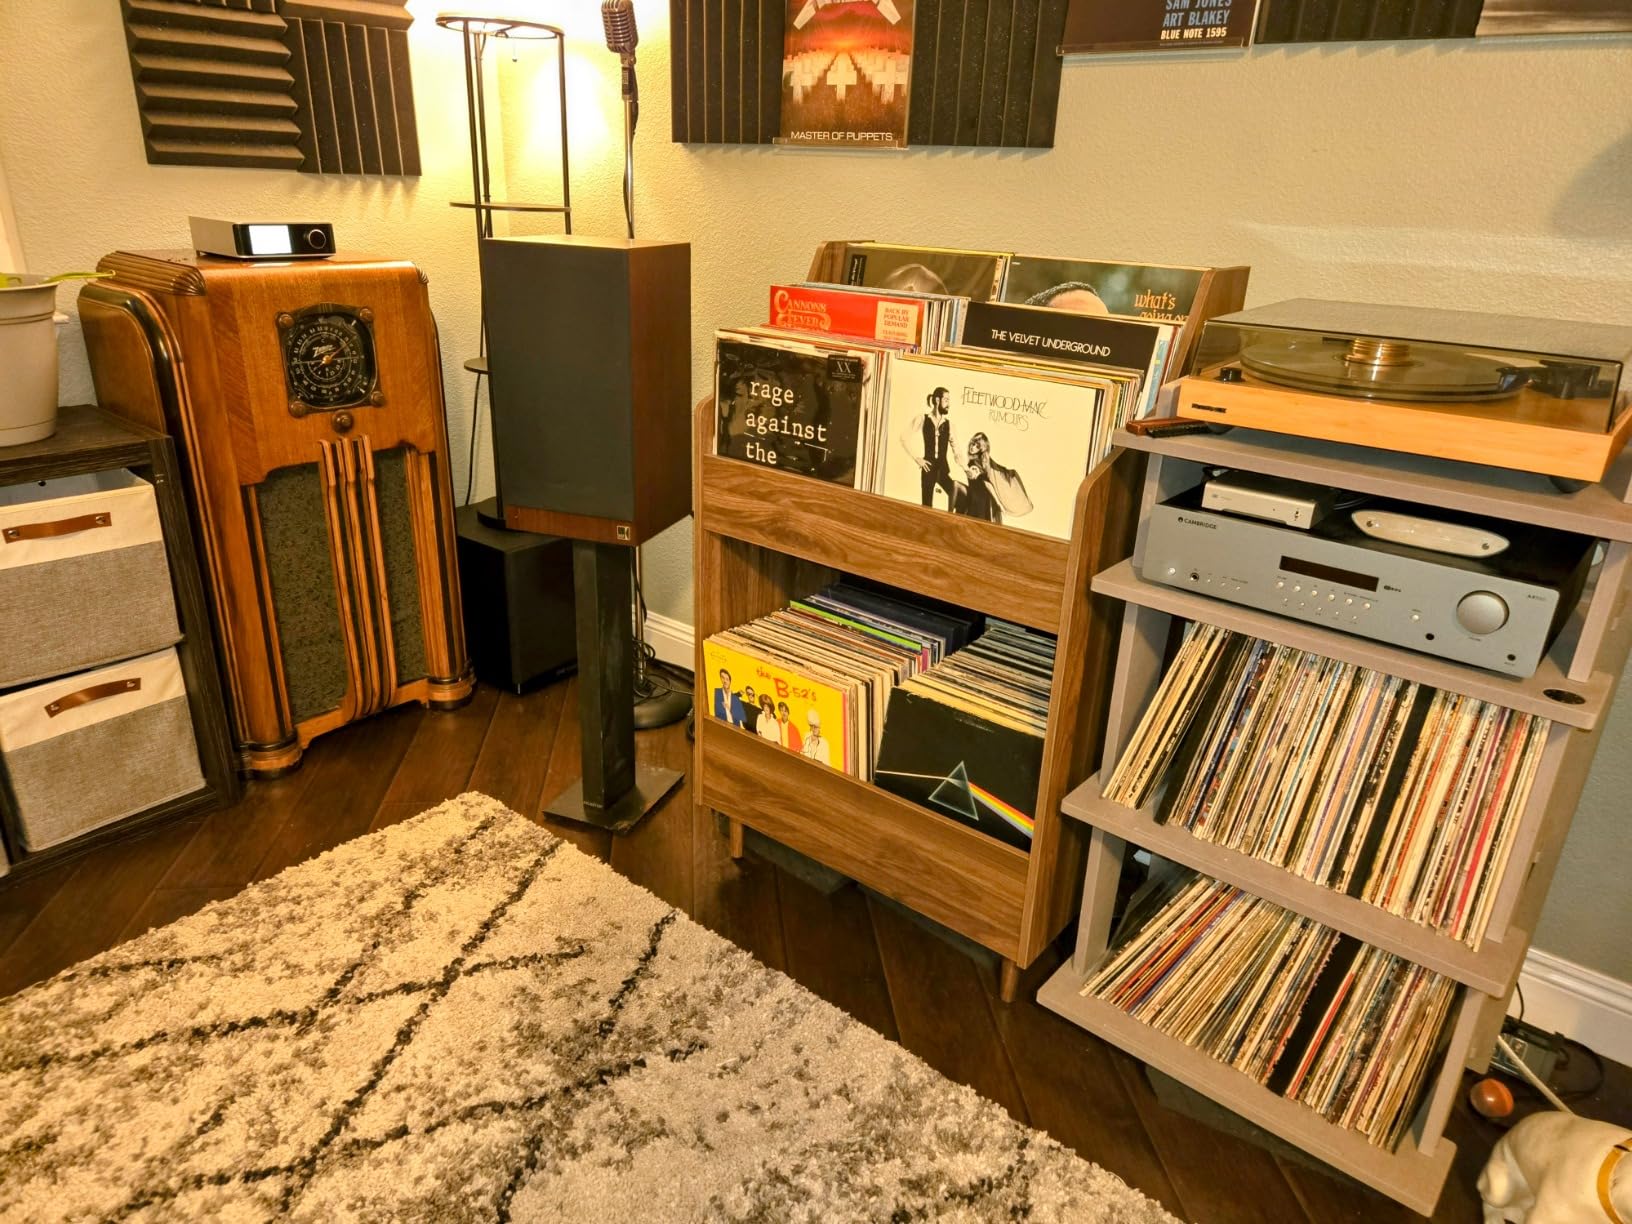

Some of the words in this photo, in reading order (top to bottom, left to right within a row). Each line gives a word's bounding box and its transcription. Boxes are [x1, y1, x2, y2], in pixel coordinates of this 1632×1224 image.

[1165, 0, 1190, 10] SAM
[1162, 12, 1184, 27] ART
[1188, 9, 1231, 26] BLAKEY
[1160, 29, 1181, 40] BLUE
[1183, 28, 1203, 39] NOTE
[1205, 27, 1228, 38] 1595
[790, 131, 830, 140] MASTER
[831, 132, 845, 141] OF
[846, 132, 893, 141] PUPPETS
[1134, 289, 1176, 310] what's
[991, 328, 1008, 341] THE
[1008, 331, 1041, 347] VELVET
[1041, 337, 1111, 357] UNDERGROUND
[750, 380, 794, 407] rage
[962, 386, 1021, 411] FLEETWOOD
[745, 412, 828, 442] against
[745, 441, 778, 465] the
[1183, 518, 1217, 530] CAMBRIDGE
